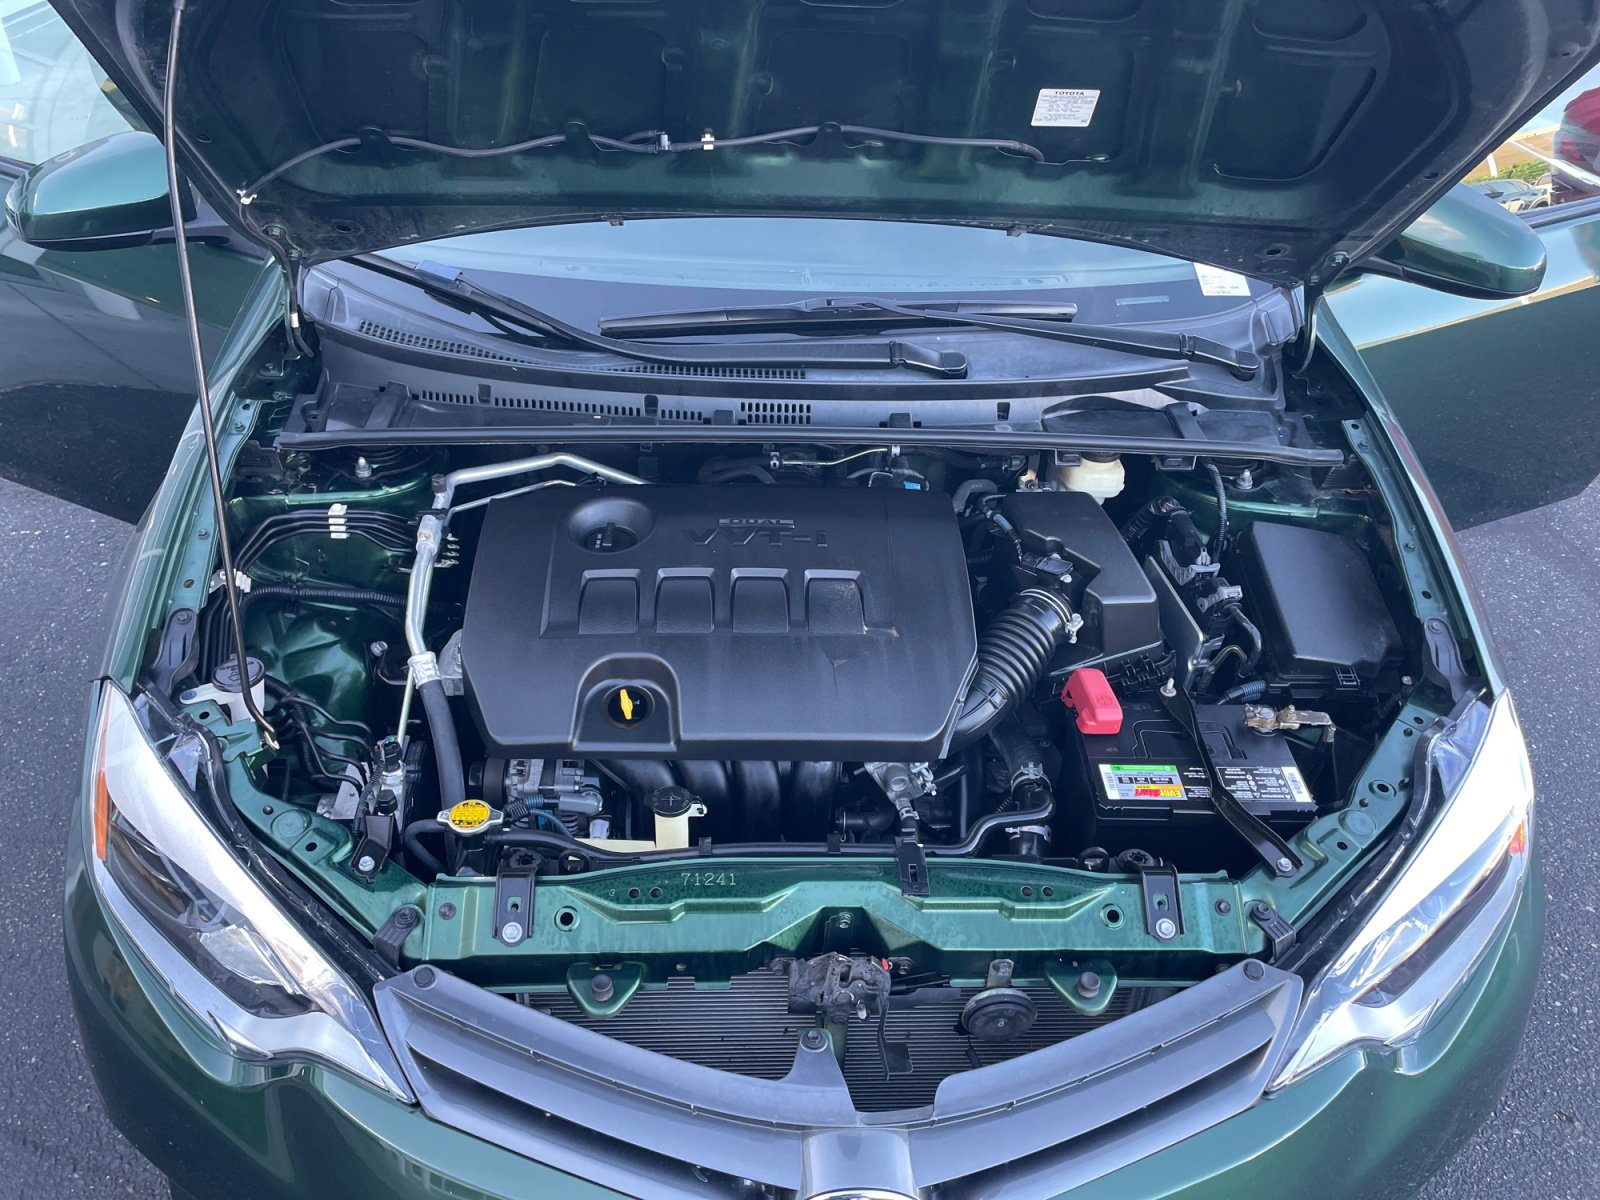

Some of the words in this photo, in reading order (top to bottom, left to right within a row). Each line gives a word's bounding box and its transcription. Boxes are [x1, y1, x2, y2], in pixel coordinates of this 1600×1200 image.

[728, 518, 794, 526] DUAL
[1135, 788, 1182, 799] EverStart
[681, 873, 736, 886] 71241
